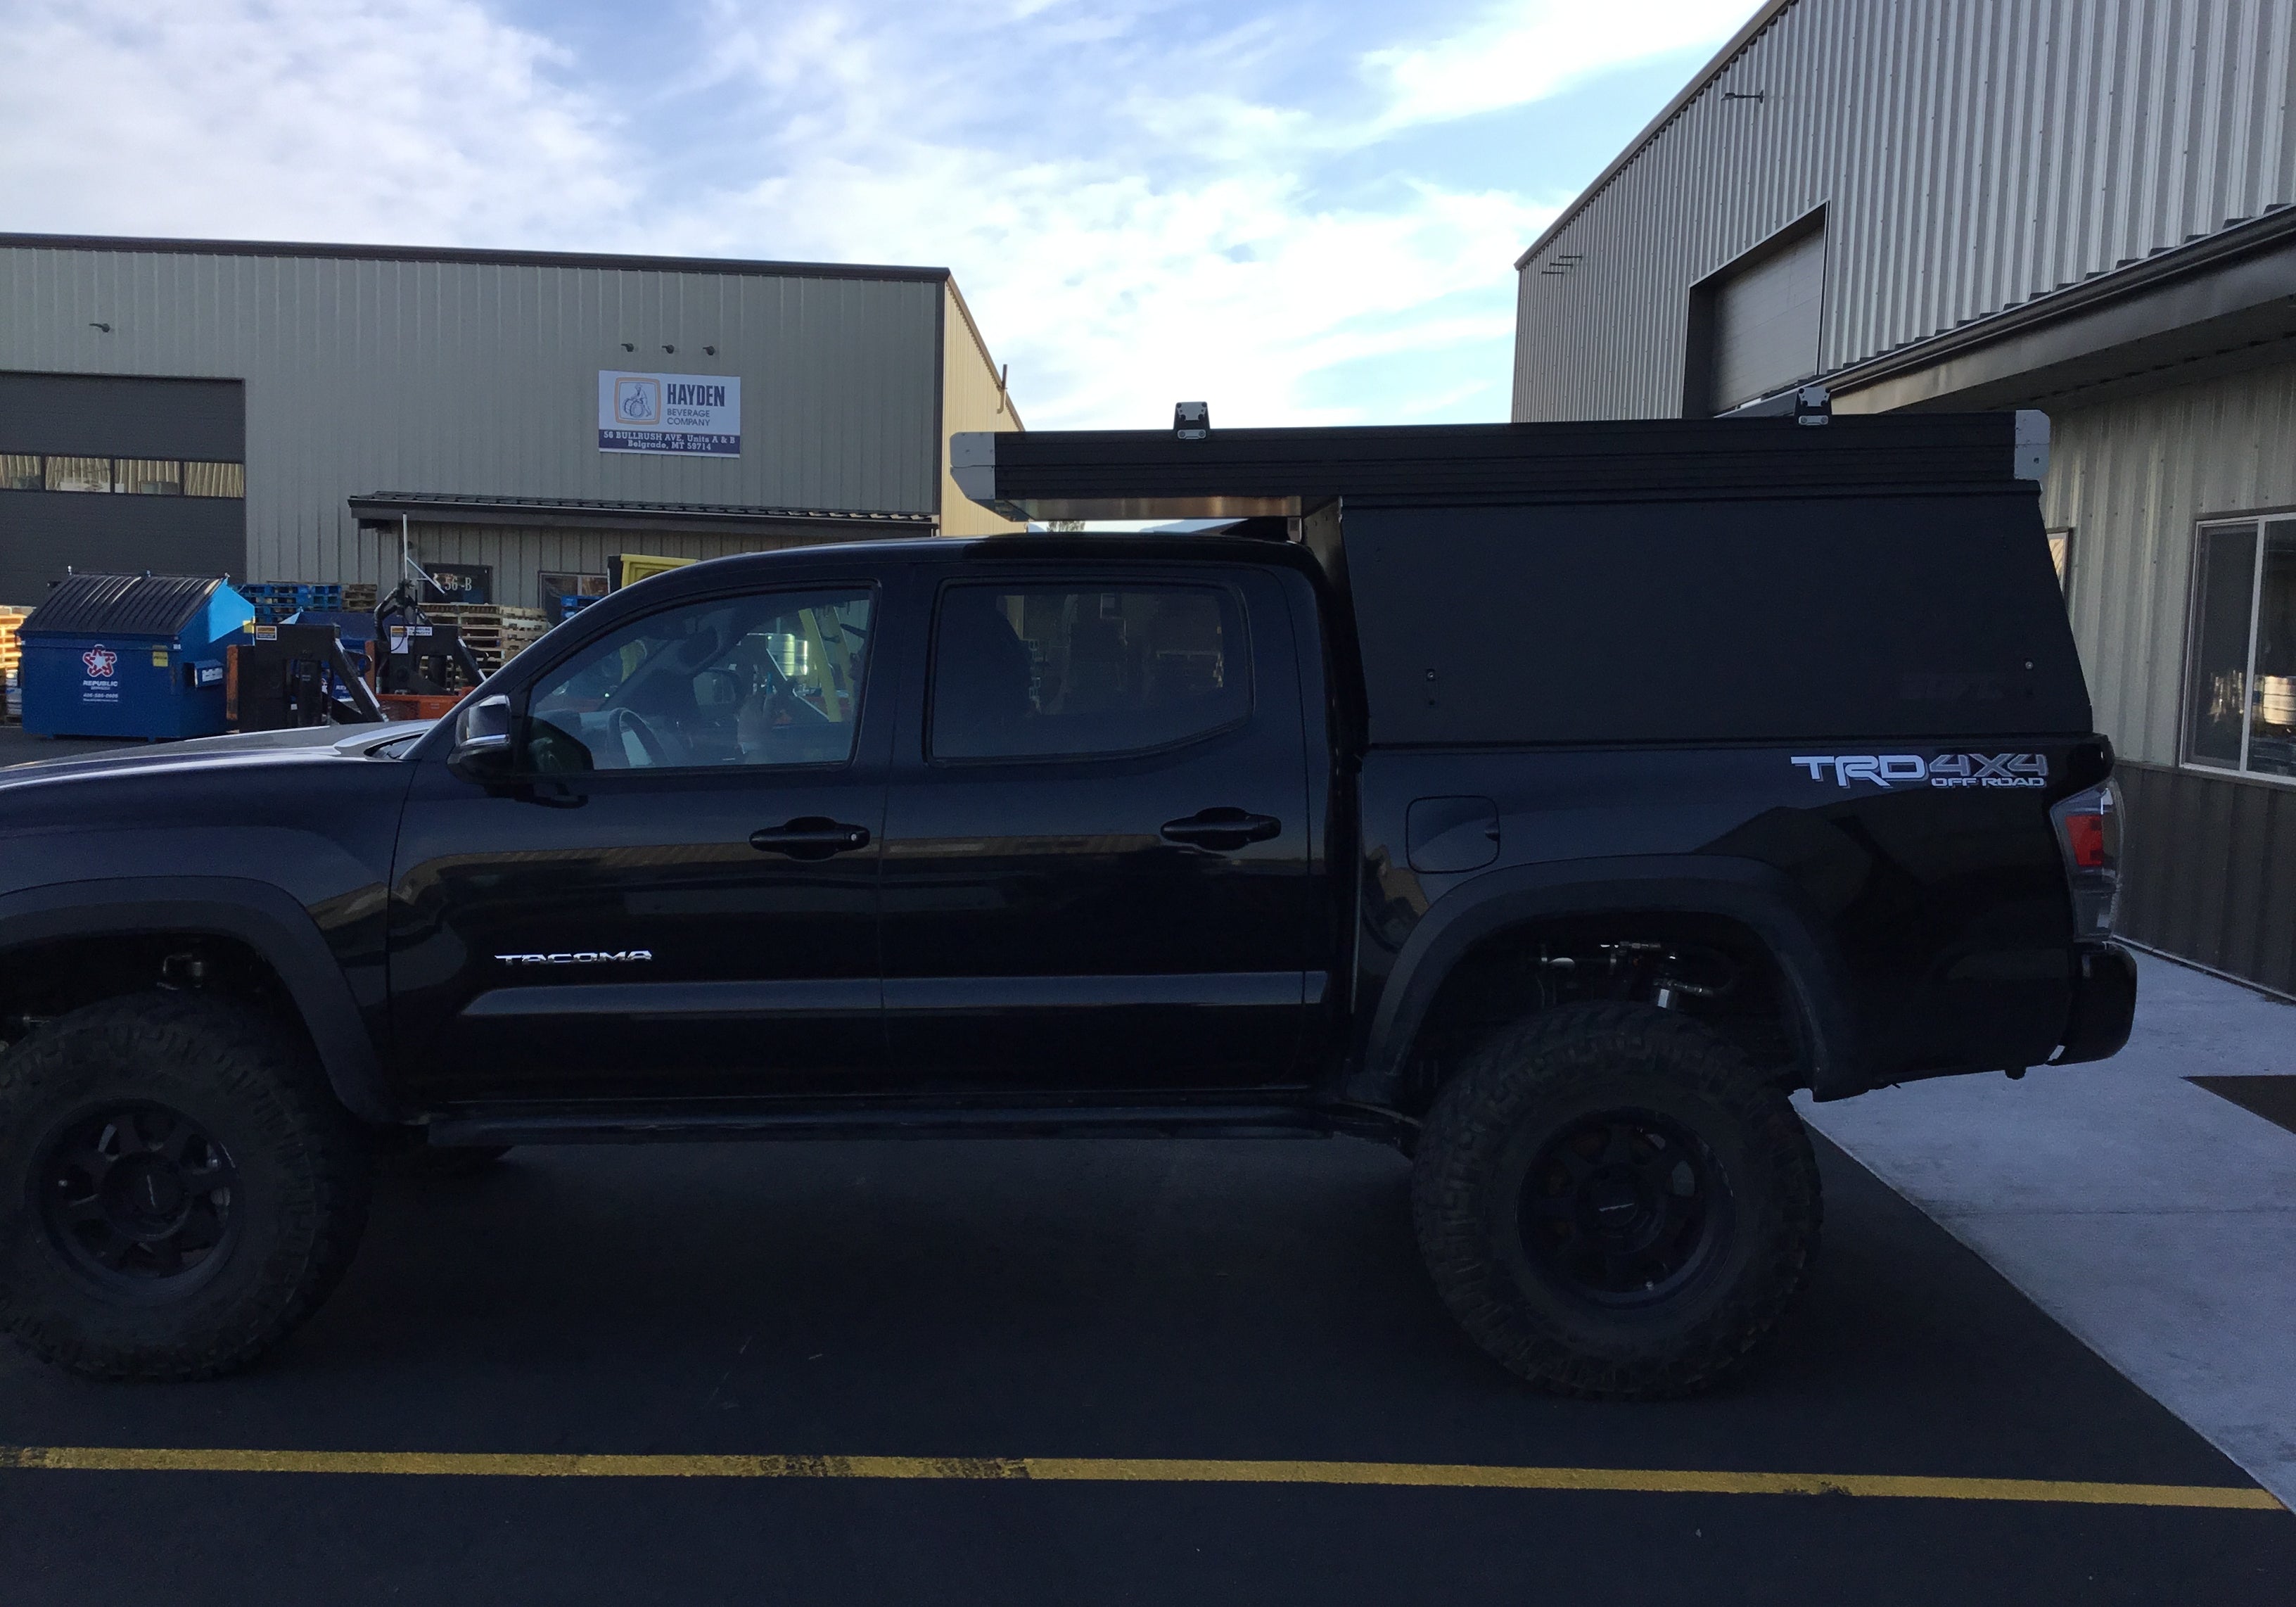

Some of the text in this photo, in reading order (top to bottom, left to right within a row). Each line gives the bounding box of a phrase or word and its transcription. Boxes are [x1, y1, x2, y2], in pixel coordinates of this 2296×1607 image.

[667, 383, 725, 407] HAYDEN
[667, 408, 710, 417] BEVERAGE
[667, 417, 710, 426] COMPANY
[616, 432, 663, 440] BULLRUSH
[687, 443, 711, 451] 59714
[1931, 777, 2046, 787] OFF ROAD
[495, 951, 653, 965] TACOMA
